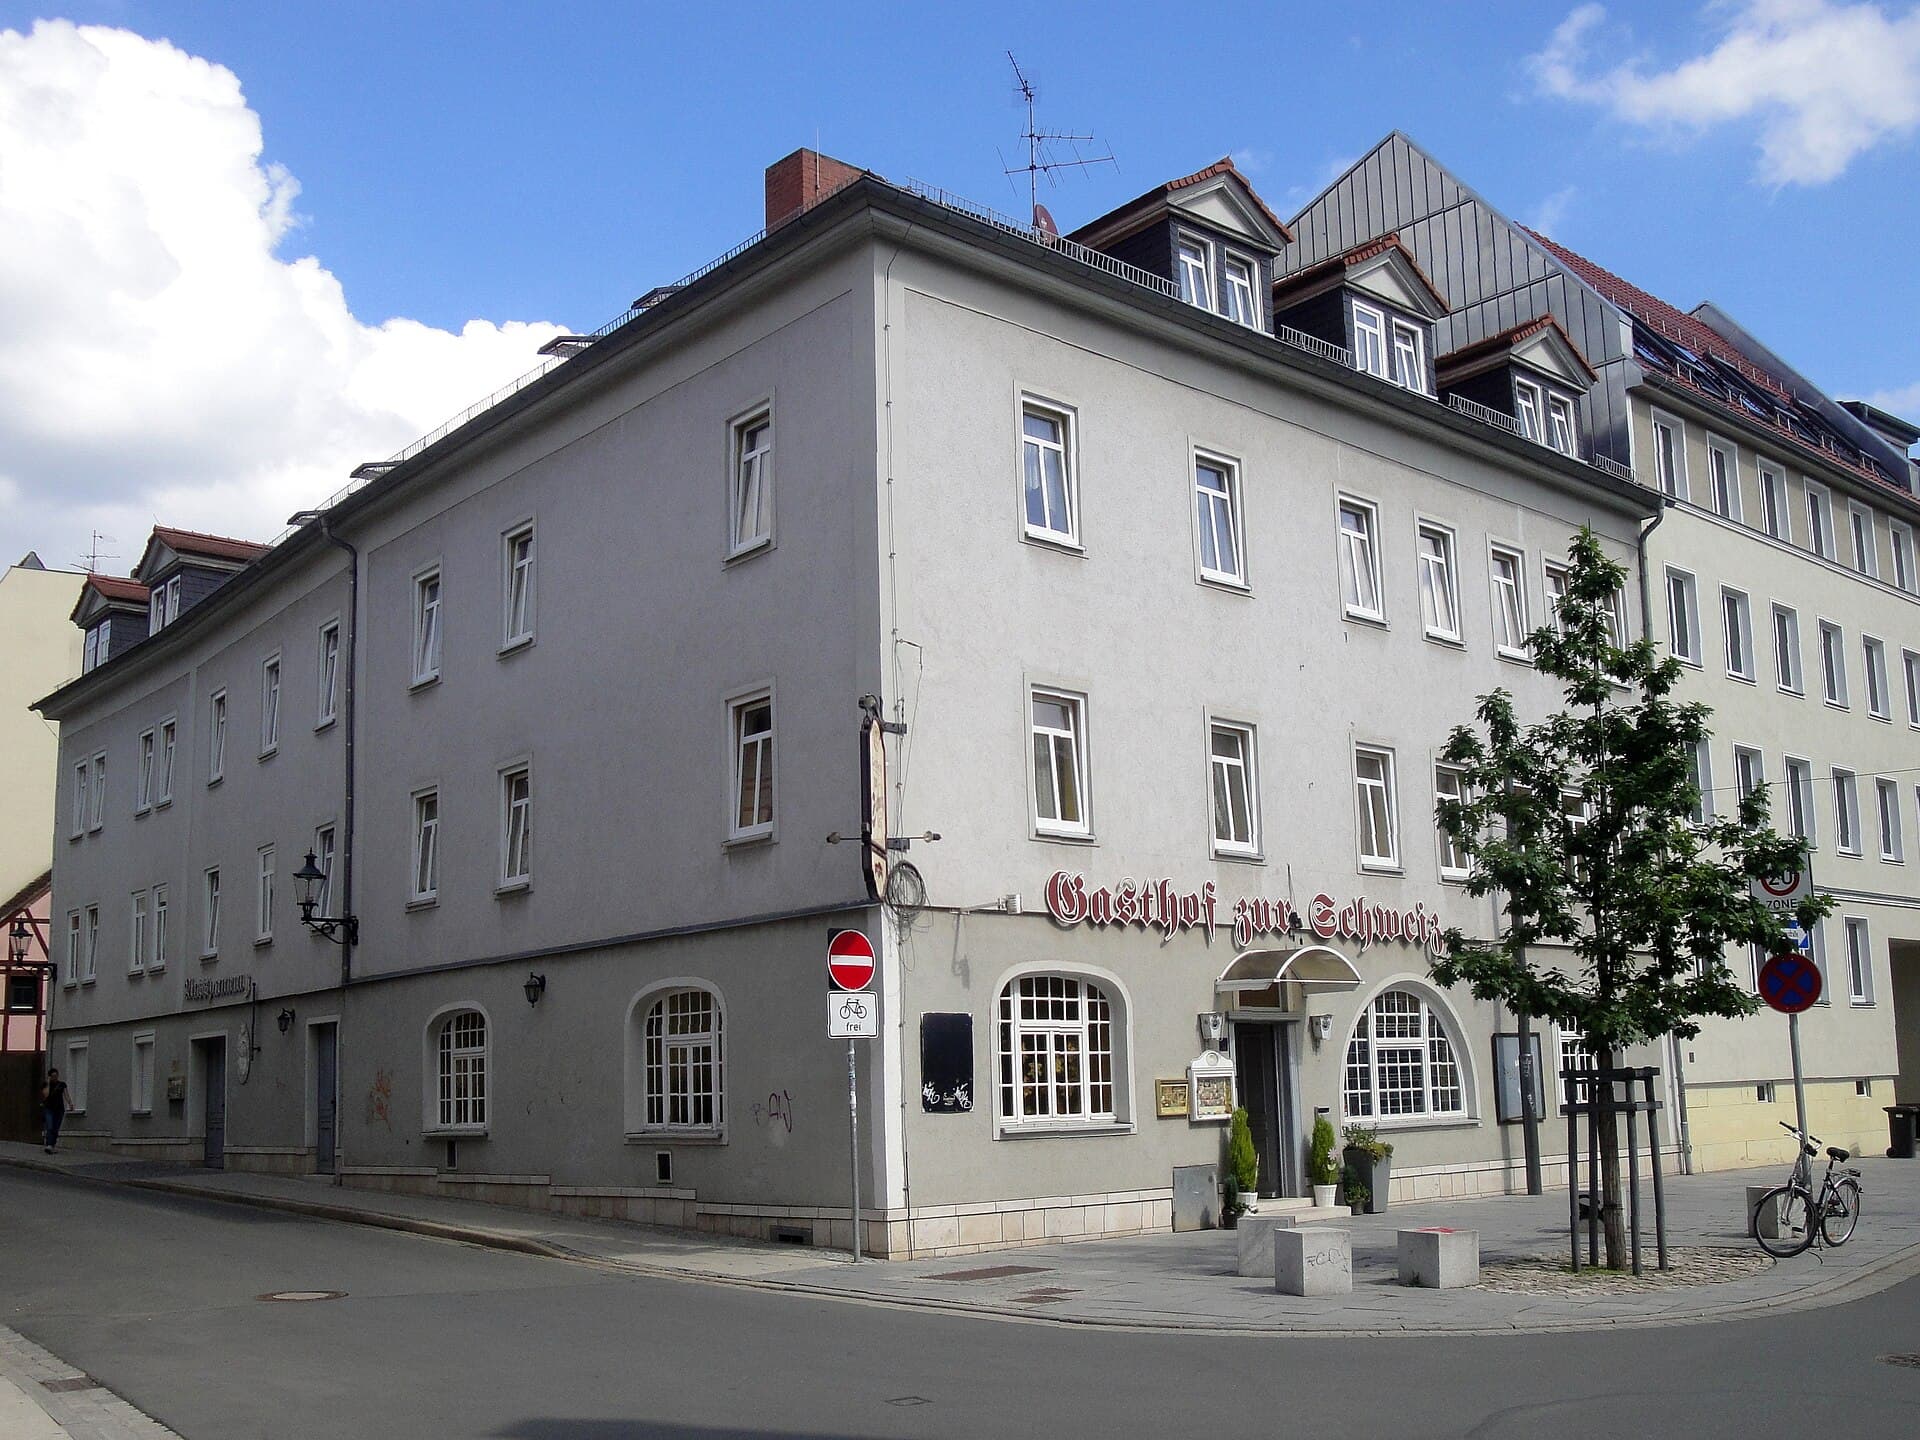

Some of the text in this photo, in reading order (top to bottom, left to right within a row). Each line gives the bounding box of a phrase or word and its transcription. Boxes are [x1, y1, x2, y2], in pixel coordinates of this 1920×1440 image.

[1765, 898, 1798, 910] ZONE
[1047, 869, 1444, 956] Gasthof zur Schweiz
[846, 1021, 862, 1032] frei
